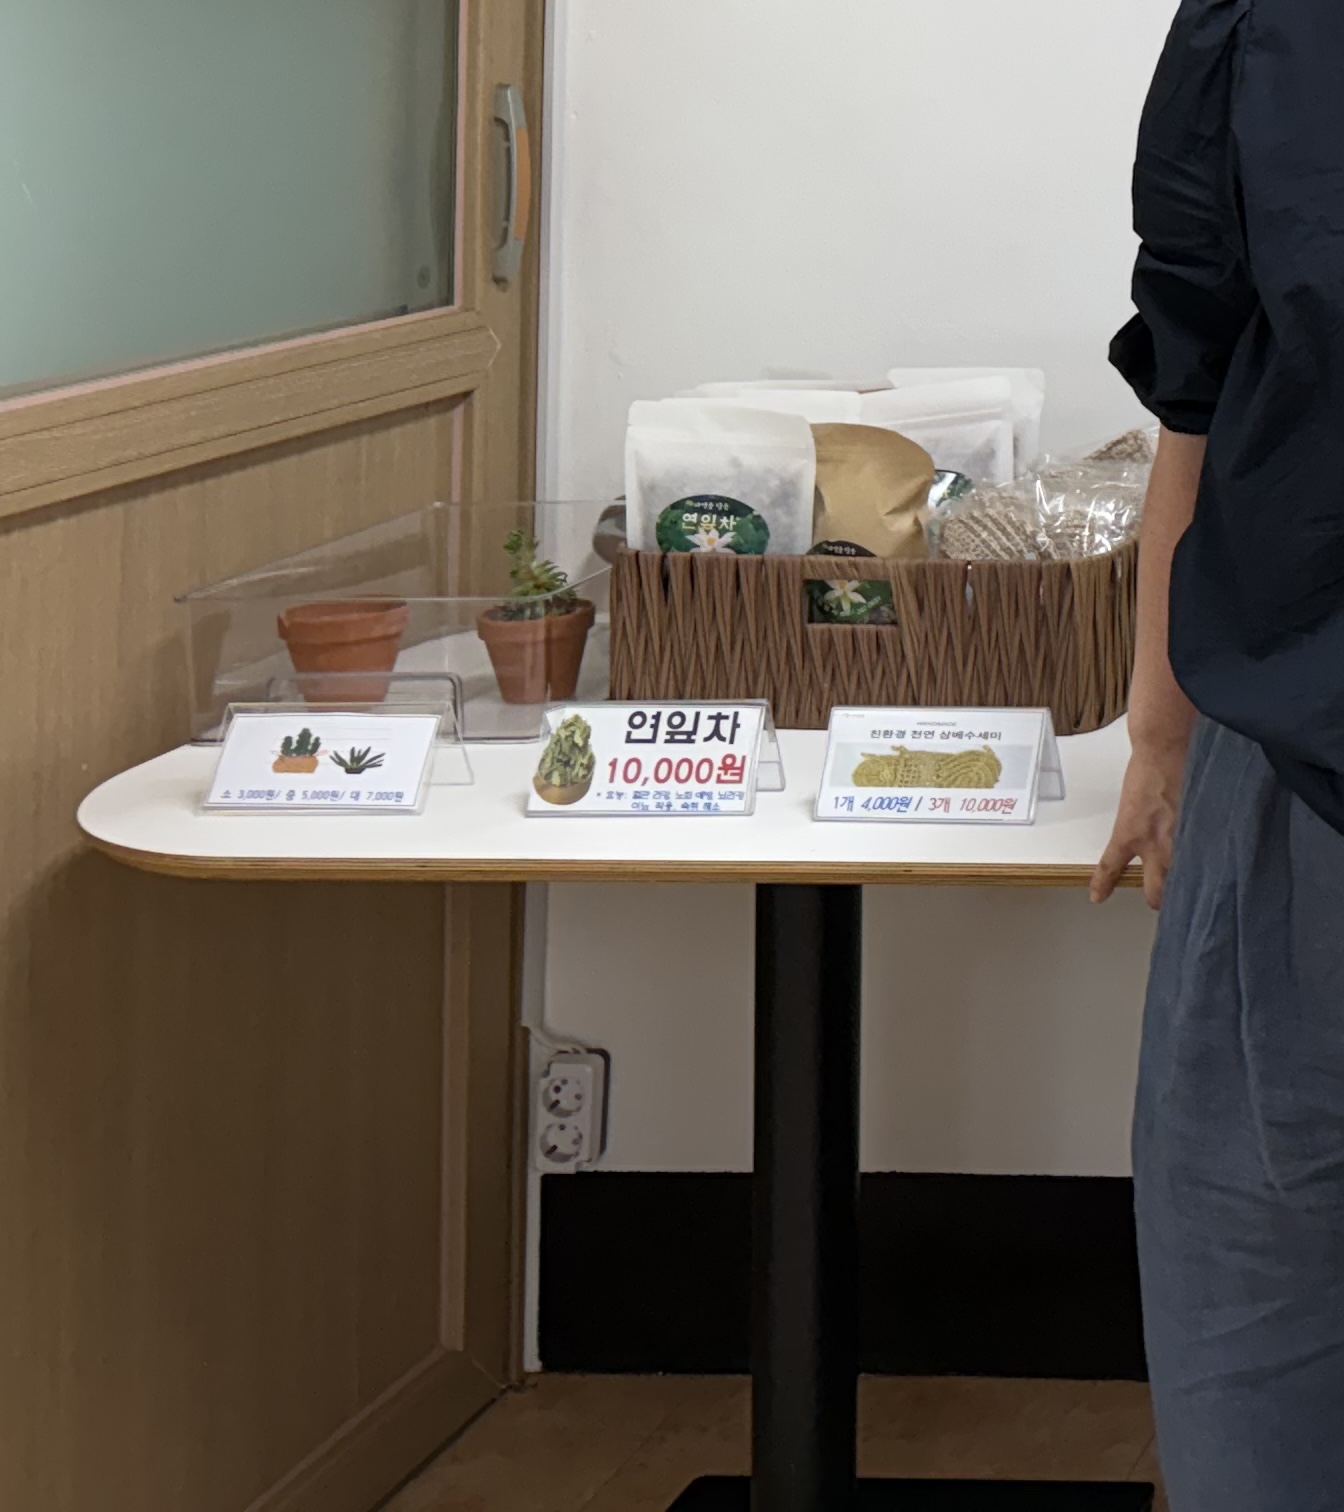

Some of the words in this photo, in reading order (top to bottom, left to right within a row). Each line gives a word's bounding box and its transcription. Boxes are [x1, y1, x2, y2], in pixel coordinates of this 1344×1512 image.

[682, 512, 737, 531] 연잎차
[624, 710, 741, 745] 연잎차
[870, 729, 906, 739] 친환경
[911, 729, 935, 739] 천연
[939, 730, 1002, 741] 삼베수세미
[608, 753, 747, 786] 10,000원
[834, 796, 855, 812] 1개
[860, 796, 913, 813] 4,000원
[928, 798, 951, 813] 3개
[959, 798, 1018, 815] 10,000원
